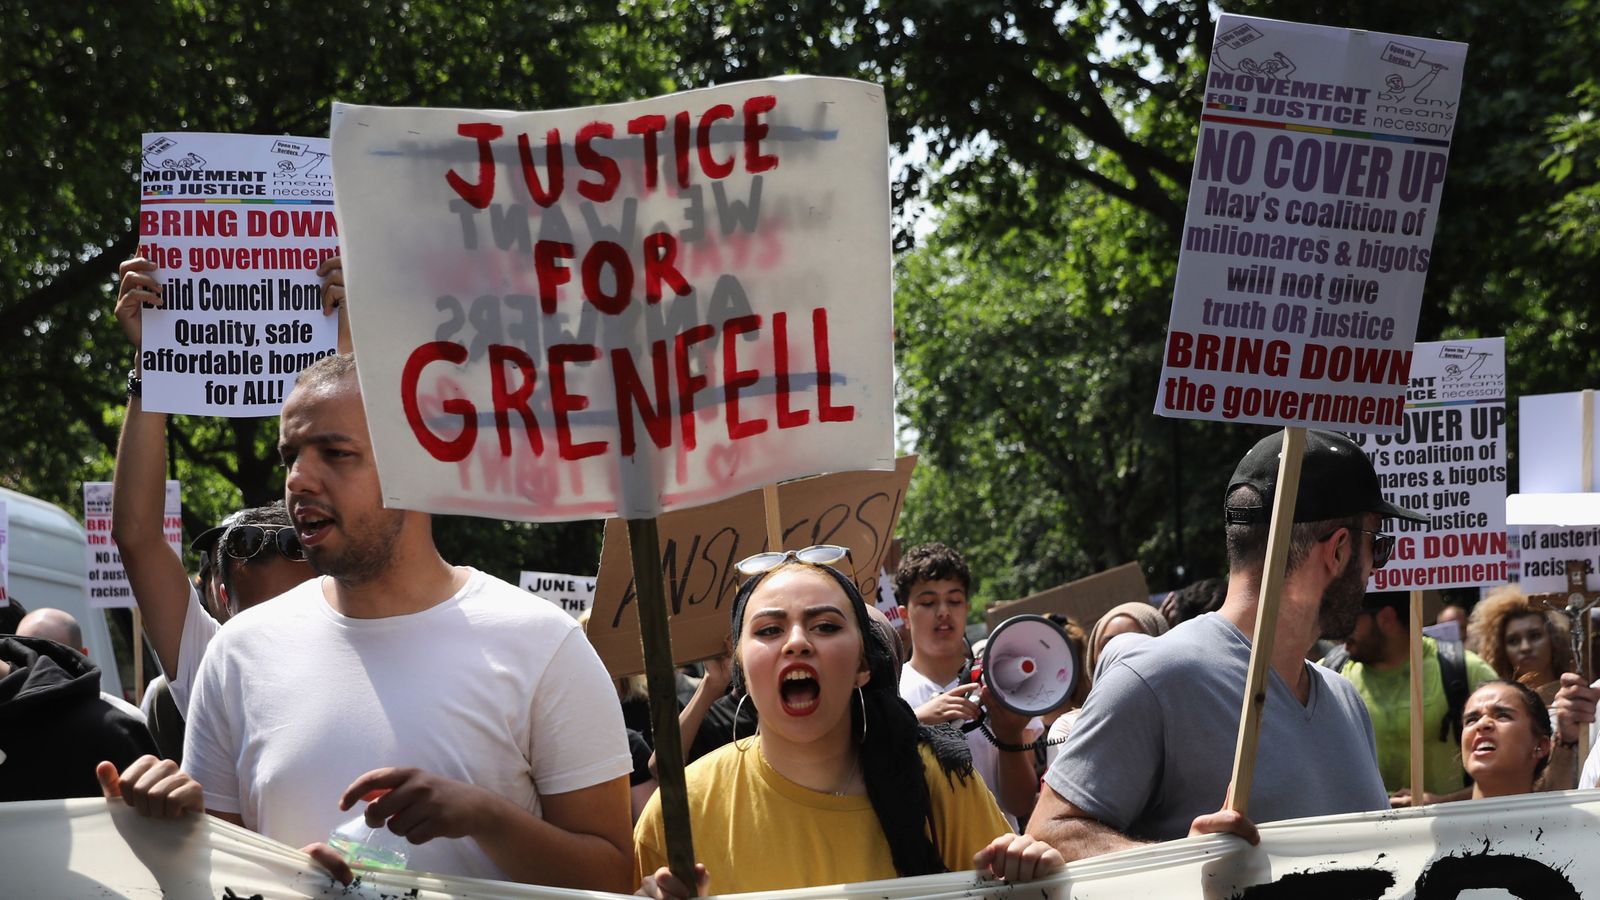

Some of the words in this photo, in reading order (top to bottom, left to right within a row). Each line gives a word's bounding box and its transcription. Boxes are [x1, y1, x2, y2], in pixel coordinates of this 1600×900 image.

[1208, 71, 1371, 105] MOVEMENT
[1377, 91, 1406, 103] by
[1413, 98, 1456, 109] any
[1206, 92, 1248, 106] FOR
[1253, 97, 1367, 126] JUSTICE
[1376, 105, 1454, 120] means
[1373, 116, 1452, 137] necessary
[445, 95, 779, 209] JUSTICE
[143, 170, 267, 182] MOVEMENT
[273, 171, 298, 179] by
[1198, 127, 1256, 185] NO
[1263, 135, 1393, 199] COVER
[1398, 149, 1447, 203] UP
[143, 184, 173, 193] FOR
[178, 183, 266, 195] JUSTICE
[272, 188, 333, 197] necessa
[1204, 186, 1280, 223] May's
[1285, 200, 1398, 234] coalition
[1401, 208, 1427, 236] of
[140, 210, 237, 237] BRING
[247, 210, 338, 238] DOWN
[140, 243, 182, 270] the
[1185, 224, 1330, 264] milionares
[1335, 241, 1351, 266] &
[1356, 238, 1430, 273] bigots
[534, 232, 692, 315] FOR
[1227, 265, 1276, 295] will
[1280, 272, 1325, 299] not
[1328, 274, 1379, 305] give
[143, 278, 193, 311] uild
[199, 277, 273, 311] Council
[278, 278, 321, 311] Hom
[1202, 298, 1267, 330] truth
[1272, 302, 1307, 334] OR
[1310, 307, 1395, 341] justice
[175, 319, 260, 347] Quality,
[265, 319, 312, 344] safe
[143, 348, 264, 375] affordable
[1166, 331, 1291, 377] BRING
[1300, 343, 1413, 386] DOWN
[205, 381, 238, 405] for
[242, 380, 284, 405] ALL!
[401, 307, 855, 462] GRENFELL
[1442, 388, 1504, 399] necessary
[1164, 376, 1216, 413] the
[1222, 384, 1405, 427] government
[1375, 409, 1463, 446] OVER
[1470, 406, 1506, 440] UP
[1367, 449, 1390, 467] y's
[1394, 445, 1474, 466] coalition
[1479, 442, 1496, 460] of
[1432, 470, 1444, 486] &
[1449, 465, 1506, 486] bigots
[1400, 492, 1430, 510] not
[1433, 489, 1470, 510] give
[1426, 511, 1488, 533] justice
[88, 534, 107, 546] the
[1424, 532, 1507, 559] DOWN
[1522, 530, 1537, 550] of
[1541, 527, 1600, 549] austeri
[96, 551, 110, 564] NO
[1524, 556, 1570, 577] racis
[1584, 558, 1594, 575] &
[89, 570, 99, 581] of
[528, 578, 576, 593] JUNE
[1374, 560, 1508, 590] government
[91, 586, 130, 598] racism
[560, 598, 586, 611] THE
